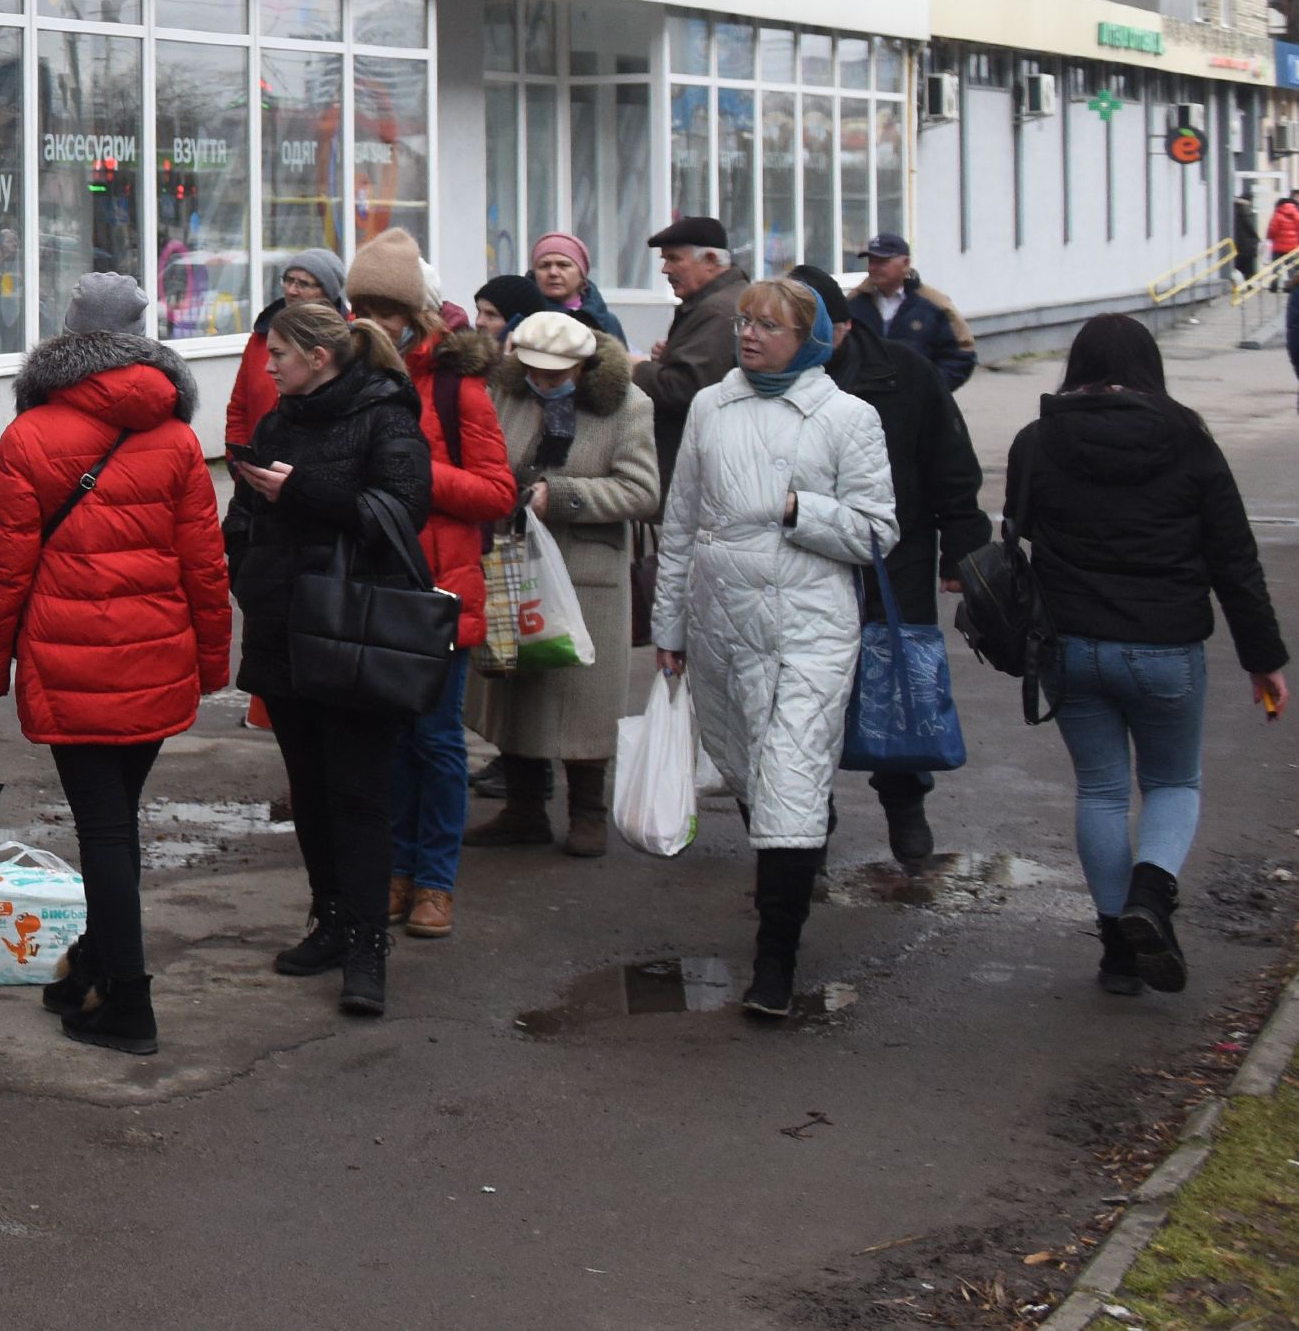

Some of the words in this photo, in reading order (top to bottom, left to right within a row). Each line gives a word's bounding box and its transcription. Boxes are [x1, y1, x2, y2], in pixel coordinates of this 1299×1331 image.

[44, 132, 136, 171] аксесуари
[173, 136, 227, 172] взуття
[281, 139, 319, 174] одяг
